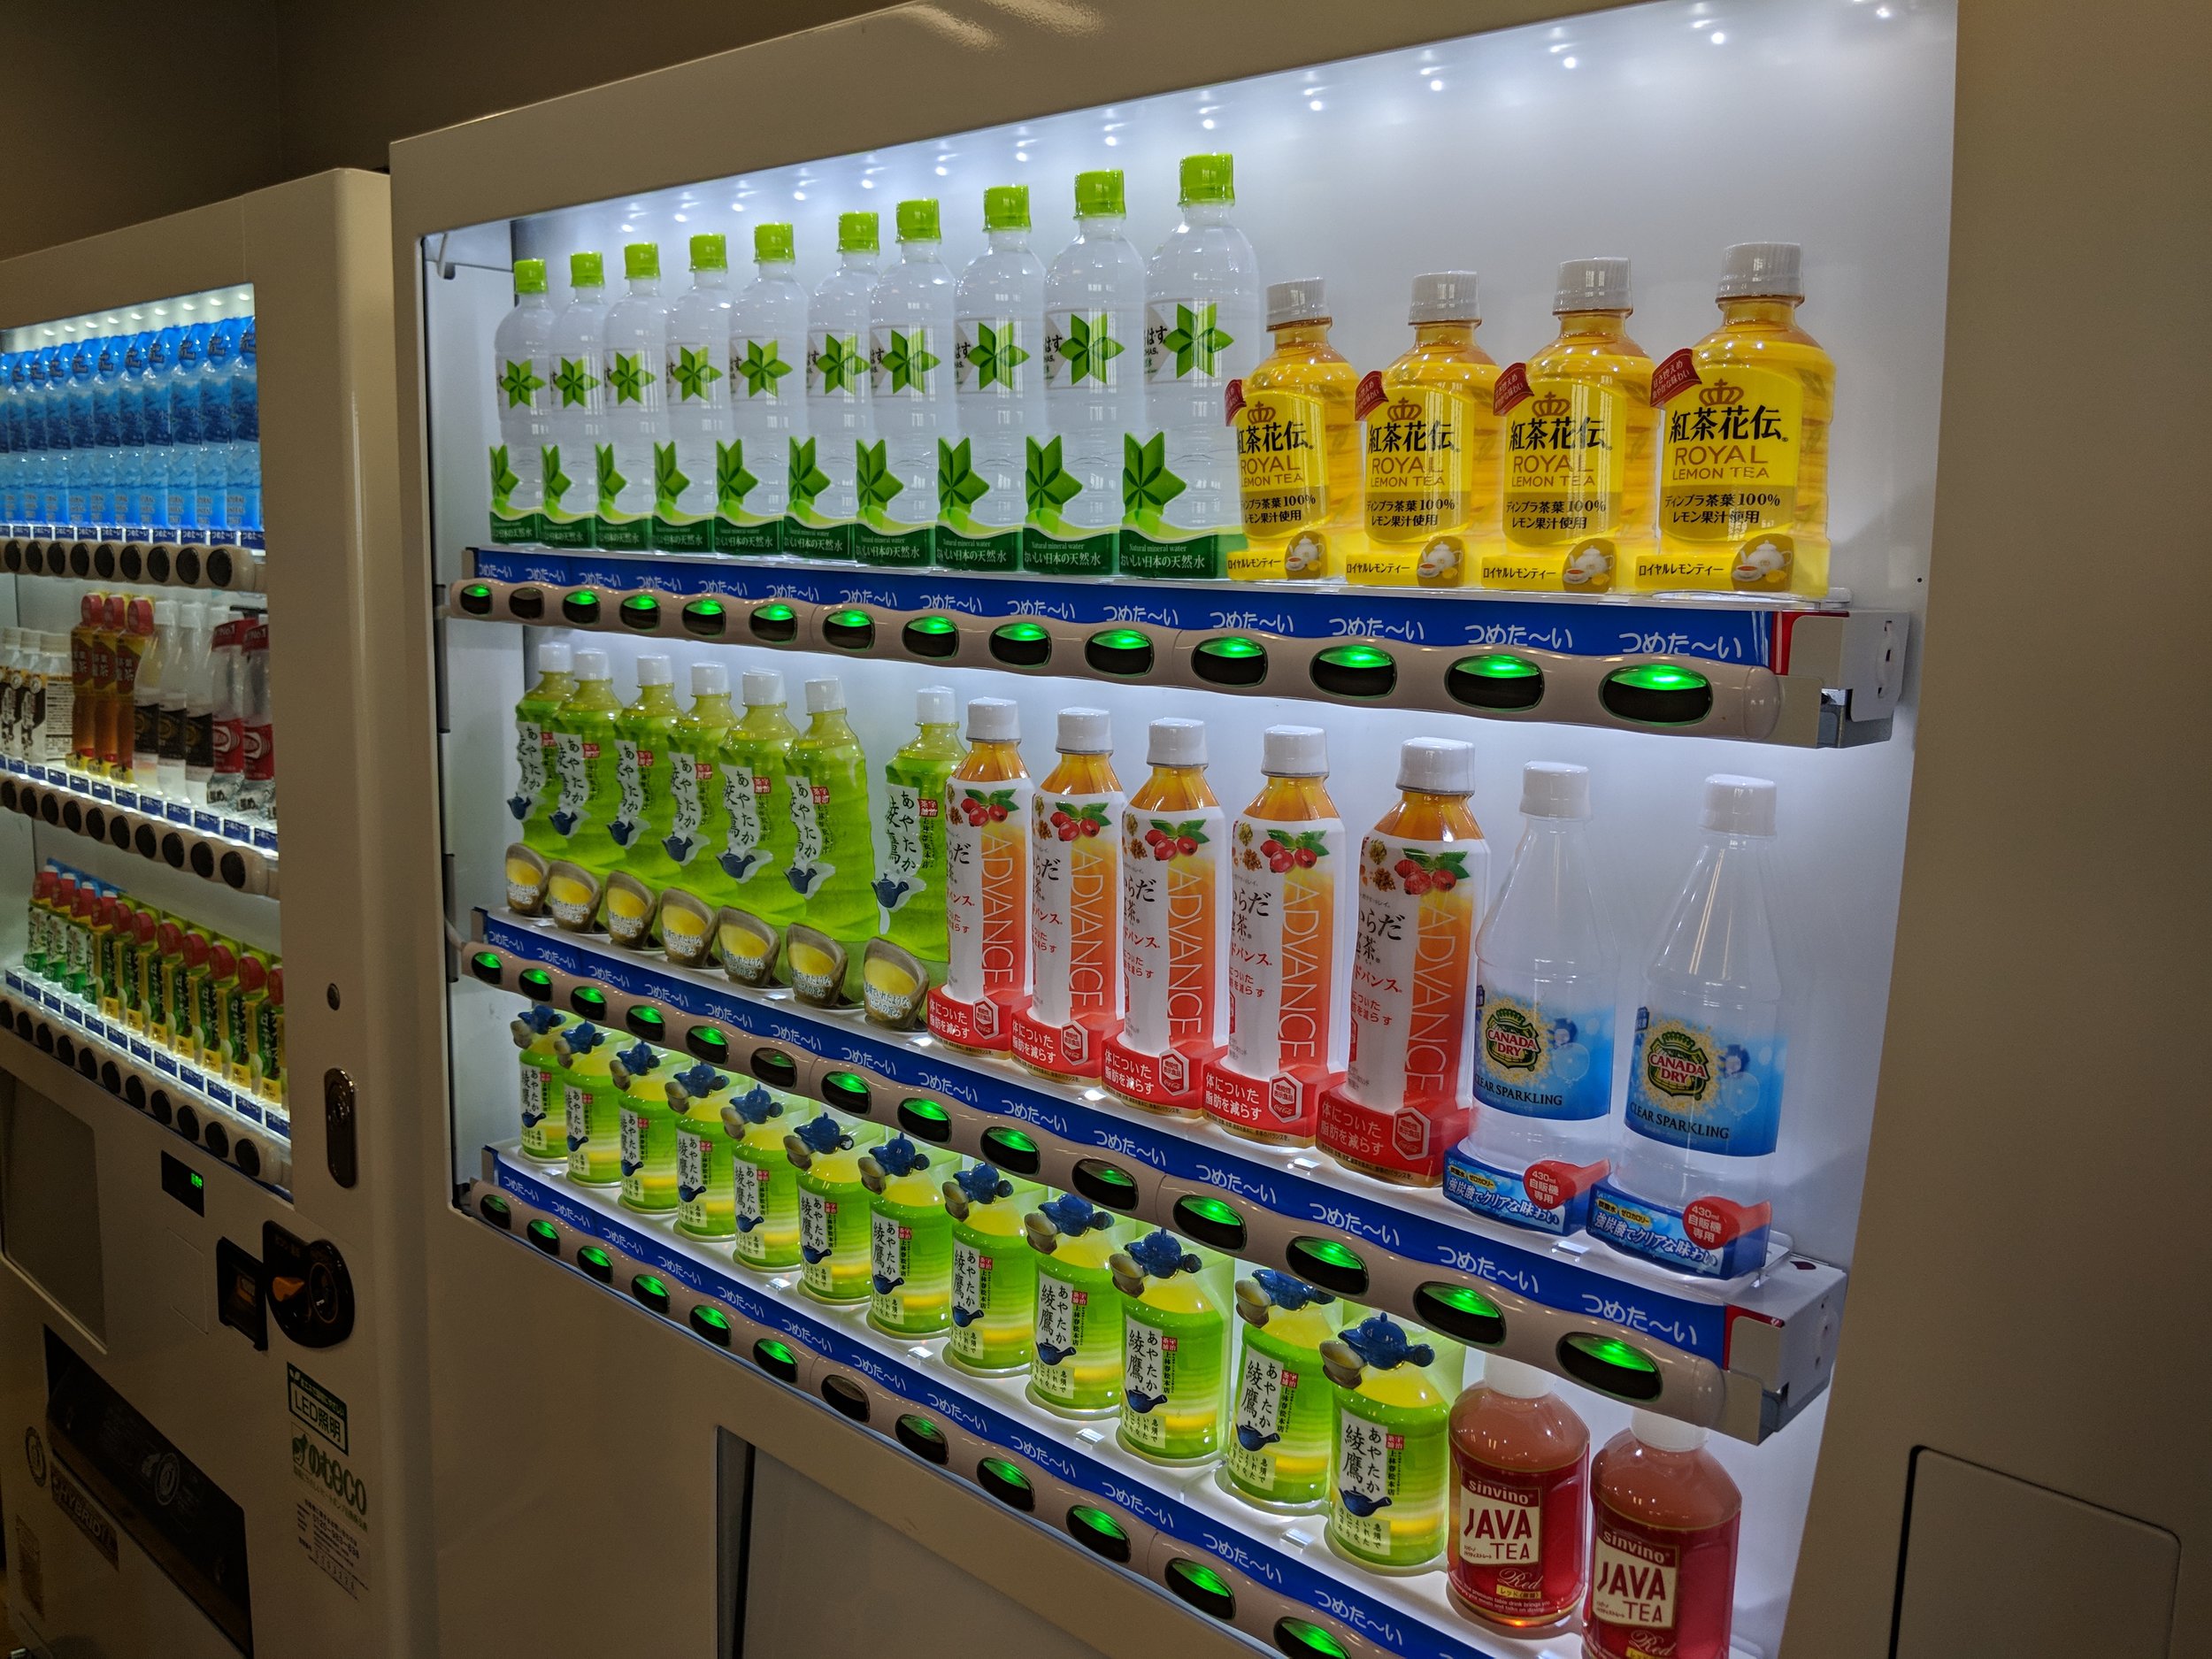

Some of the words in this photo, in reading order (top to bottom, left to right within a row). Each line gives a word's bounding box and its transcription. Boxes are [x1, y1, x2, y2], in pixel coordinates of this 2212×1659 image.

[1368, 421, 1453, 454] 紅茶花伝
[1509, 416, 1606, 453] 紅茶花伝
[1669, 405, 1782, 444] 紅茶花伝
[1240, 455, 1301, 474] ROYAL
[1371, 456, 1444, 473] ROYAL
[1513, 455, 1594, 473] ROYAL
[1674, 444, 1768, 465] ROYAL
[1274, 473, 1303, 484] TEA
[1371, 477, 1408, 488] LEMON
[1412, 475, 1446, 487] TEA
[1512, 476, 1554, 488] LEMON
[1559, 475, 1596, 487] TEA
[1672, 468, 1722, 480] LEMON
[1729, 465, 1770, 479] TEA
[1371, 515, 1438, 527] レモン果汁使用
[1512, 516, 1587, 530] レモン果汁使用
[1672, 511, 1759, 525] レモン果汁使用
[1228, 558, 1281, 570] ロイヤルレモンティー
[1347, 562, 1410, 574] ロイヤルレモンティー
[1483, 567, 1556, 580] ロイヤルレモンティー
[1639, 564, 1724, 577] ロイヤルレモンティー
[900, 791, 918, 871] あやたか
[980, 833, 1014, 983] ADVANCE
[1070, 849, 1104, 1007] ADVANCE
[1167, 868, 1202, 1033] ADVANCE
[1279, 881, 1320, 1060] ADVANCE
[929, 999, 967, 1025] 体についた
[1405, 906, 1456, 1092] ADVANCE
[929, 1015, 970, 1039] 脂肪を減らす
[1012, 1019, 1054, 1049] 体についた
[1487, 1029, 1536, 1051] CANADA
[1012, 1036, 1056, 1064] 脂肪を減らす
[1497, 1042, 1522, 1057] DRY
[1105, 1049, 1152, 1079] 体についた
[1649, 1054, 1707, 1079] CANADA
[1661, 1068, 1689, 1084] DRY
[1105, 1066, 1154, 1094] 脂肪を減らす
[1206, 1072, 1260, 1104] 体についた
[1205, 1090, 1262, 1121] 脂肪を減らす
[1495, 1084, 1563, 1106] SPARKLING
[1322, 1100, 1382, 1139] 体についた
[1630, 1102, 1655, 1123] CLEAR
[1655, 1113, 1730, 1140] SPARKLING
[1320, 1119, 1384, 1156] 脂肪を減らす
[1529, 1179, 1560, 1197] 自販機
[1532, 1170, 1556, 1184] 430ml
[1448, 1178, 1561, 1225] 強炭酸でクリアな味わい
[1533, 1192, 1555, 1205] 専用
[1688, 1213, 1723, 1234] 自販機
[1692, 1205, 1720, 1222] 430ml
[1594, 1211, 1717, 1267] 強炭酸でクリアな味わい
[1693, 1229, 1716, 1244] 専用
[964, 1250, 976, 1309] あやたか
[1039, 1284, 1056, 1337] 綾鷹
[1056, 1285, 1069, 1345] あやたか
[1125, 1329, 1145, 1384] 綾鷹
[1144, 1330, 1159, 1393] あやたか
[1240, 1359, 1263, 1419] 綾鷹
[1258, 1363, 1279, 1429] あやたか
[1342, 1423, 1367, 1485] 綾鷹
[1366, 1425, 1383, 1495] あやたか
[1468, 1479, 1529, 1506] sinvino
[1463, 1508, 1532, 1540] JAVA
[1490, 1542, 1530, 1560] TEA
[1602, 1529, 1664, 1565] sinvino
[1497, 1567, 1544, 1590] Red
[1596, 1561, 1666, 1601] JAVA
[1623, 1600, 1663, 1623] TEA
[1629, 1629, 1677, 1656] Red
